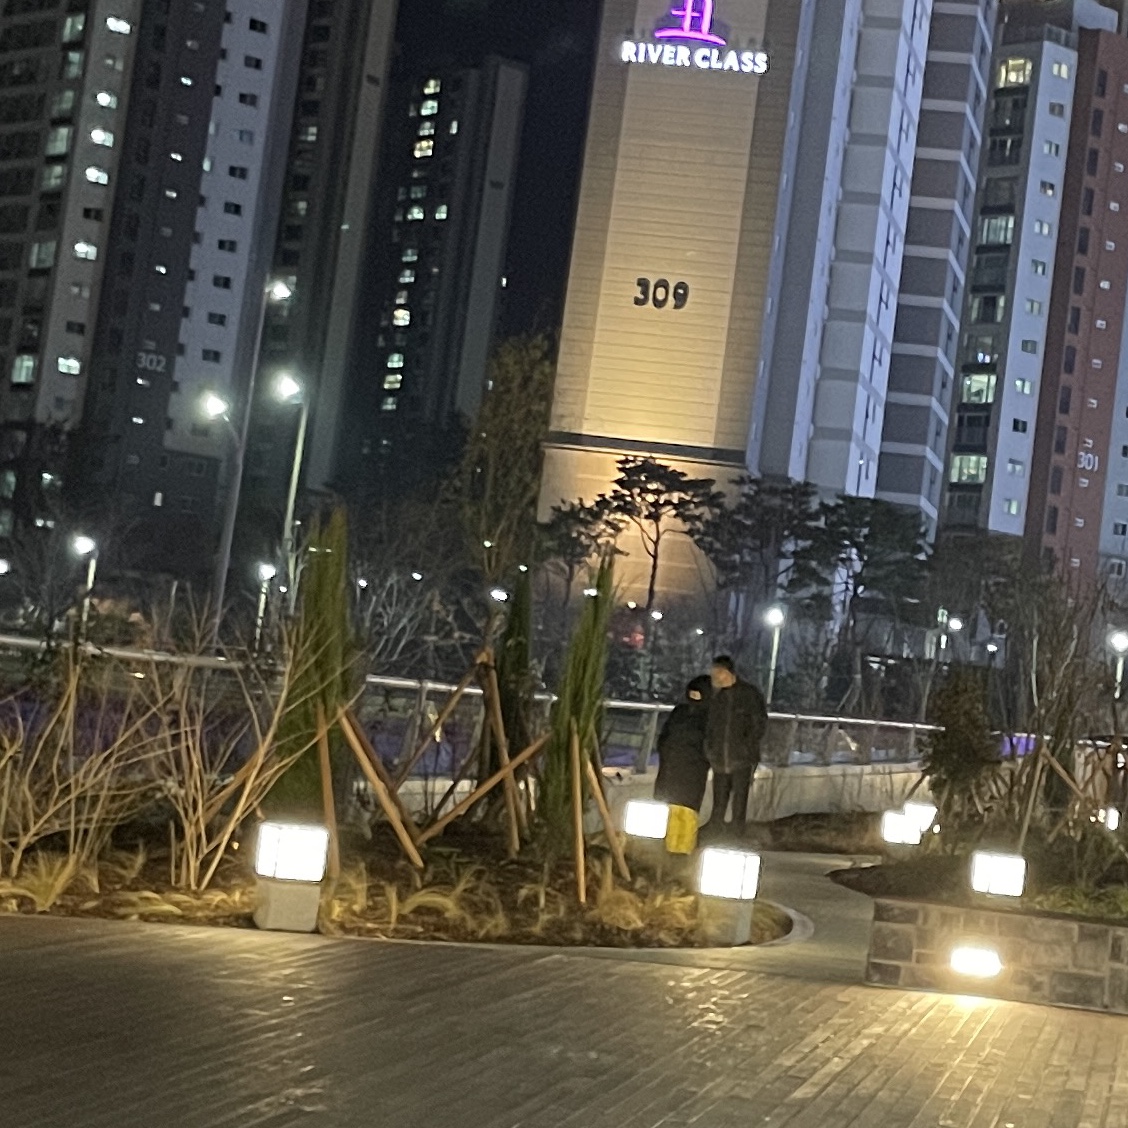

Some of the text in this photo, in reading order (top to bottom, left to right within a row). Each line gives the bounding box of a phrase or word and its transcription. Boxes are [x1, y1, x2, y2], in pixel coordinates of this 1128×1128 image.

[620, 40, 769, 74] RIVER CLASS
[633, 277, 690, 310] 309
[136, 352, 167, 372] 302
[1077, 451, 1099, 471] 301
